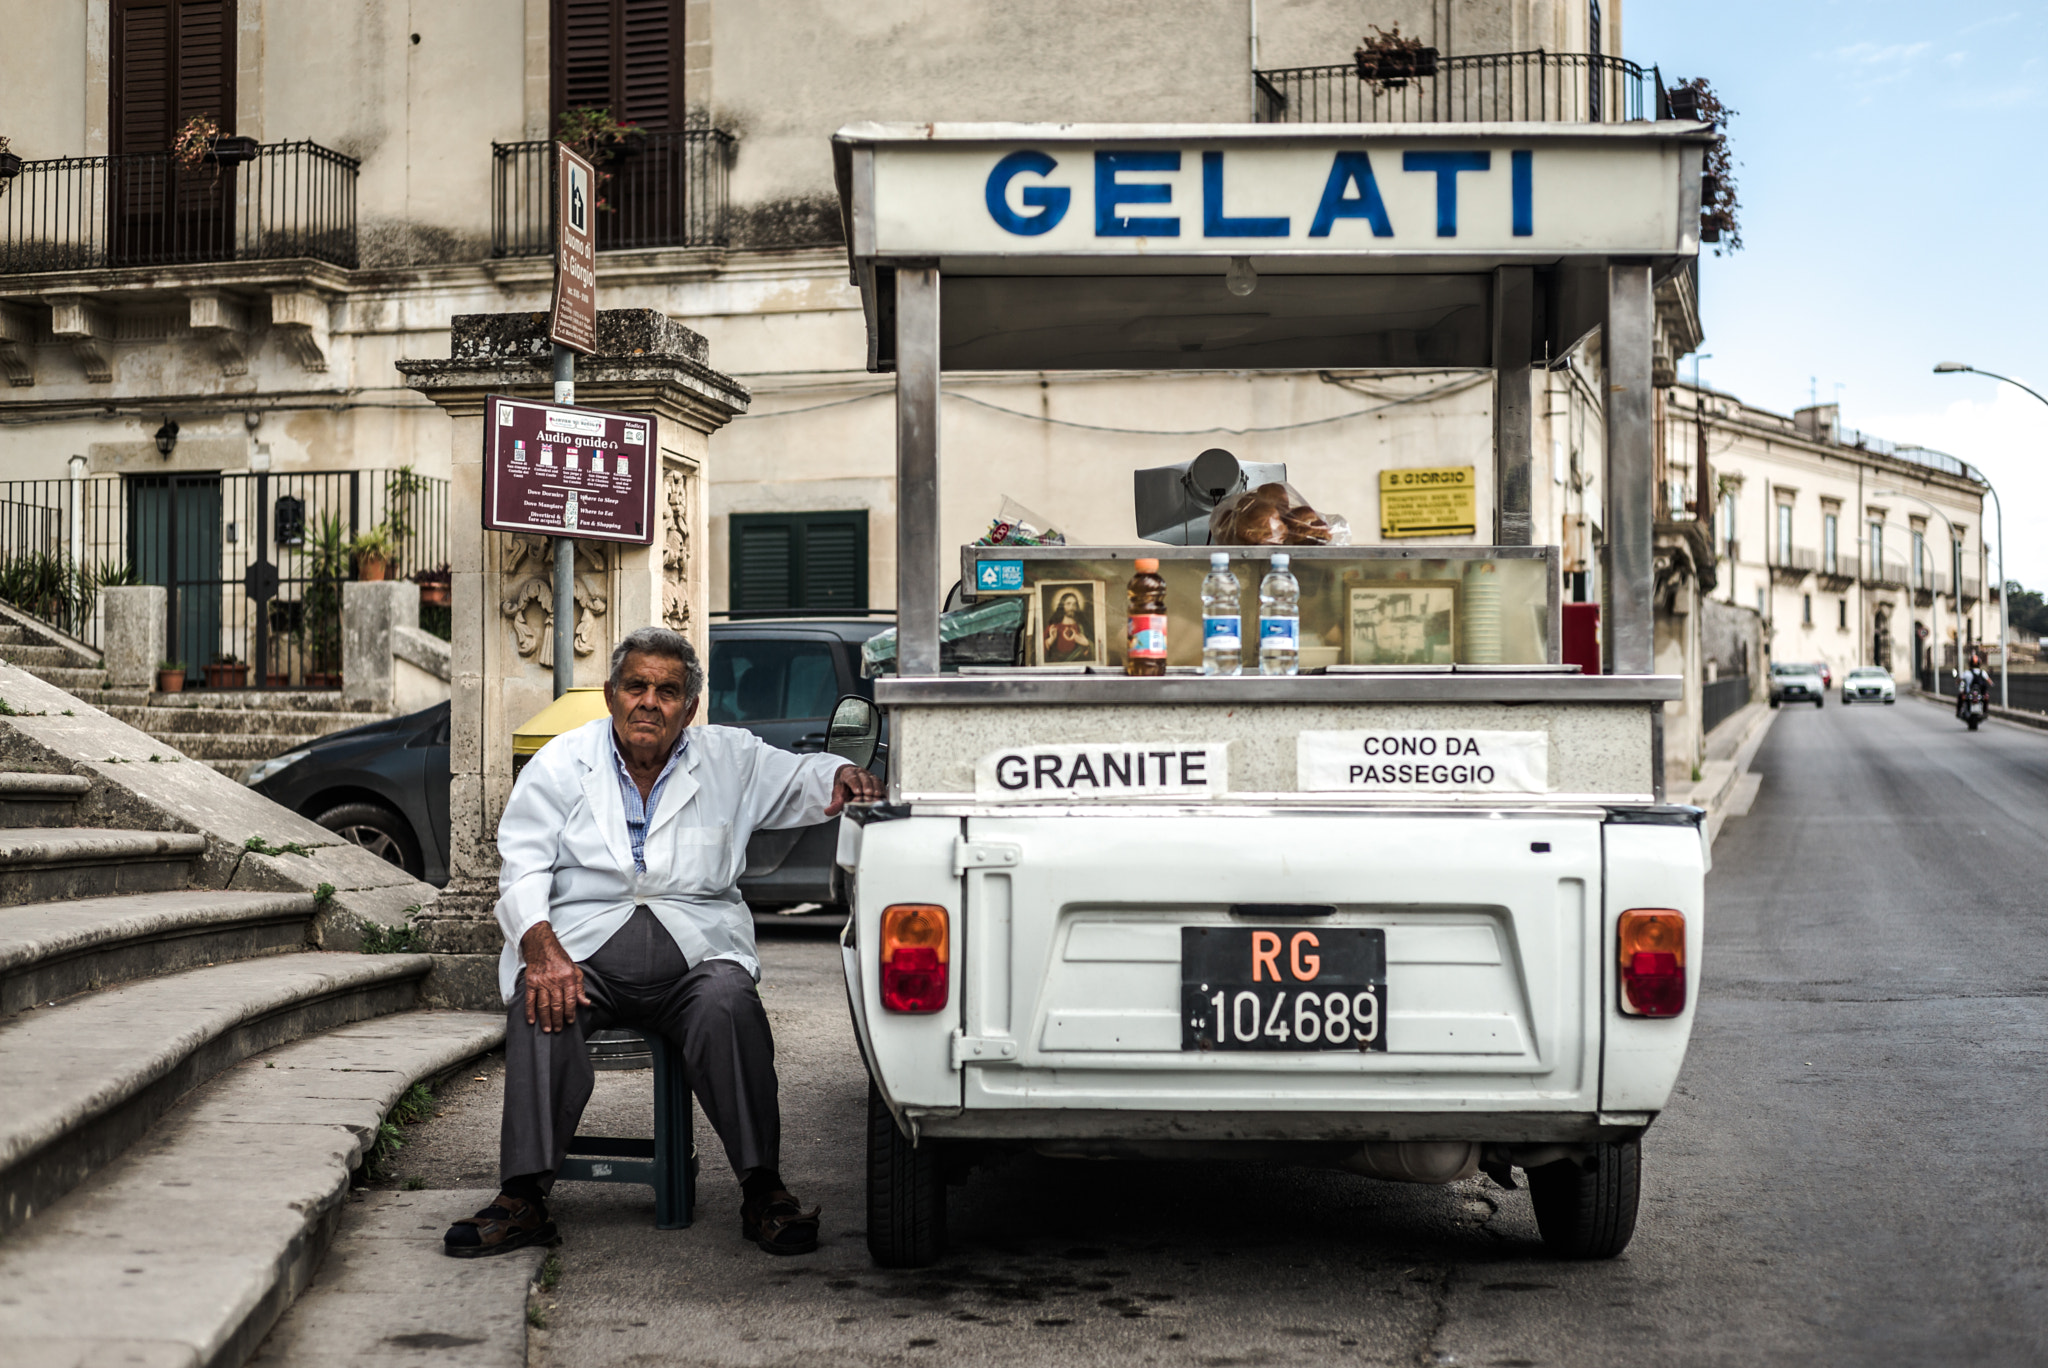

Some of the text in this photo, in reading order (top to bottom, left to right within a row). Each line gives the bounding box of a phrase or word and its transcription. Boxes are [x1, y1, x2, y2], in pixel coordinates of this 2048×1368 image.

[985, 150, 1533, 237] GELATI
[564, 226, 591, 260] Duomo di
[562, 249, 593, 289] S. Giorgio
[625, 422, 644, 430] Modica
[536, 430, 608, 449] Audio guide
[1404, 472, 1465, 484] GIORGIO
[542, 490, 564, 498] Dormire
[580, 494, 596, 502] Where
[538, 501, 564, 510] Mangiare
[596, 521, 621, 530] Shopping
[1363, 737, 1481, 757] CONO DA
[996, 751, 1208, 790] GRANITE
[1349, 764, 1495, 785] PASSEGGIO
[1252, 930, 1320, 982] RG
[1210, 990, 1379, 1044] 104689
